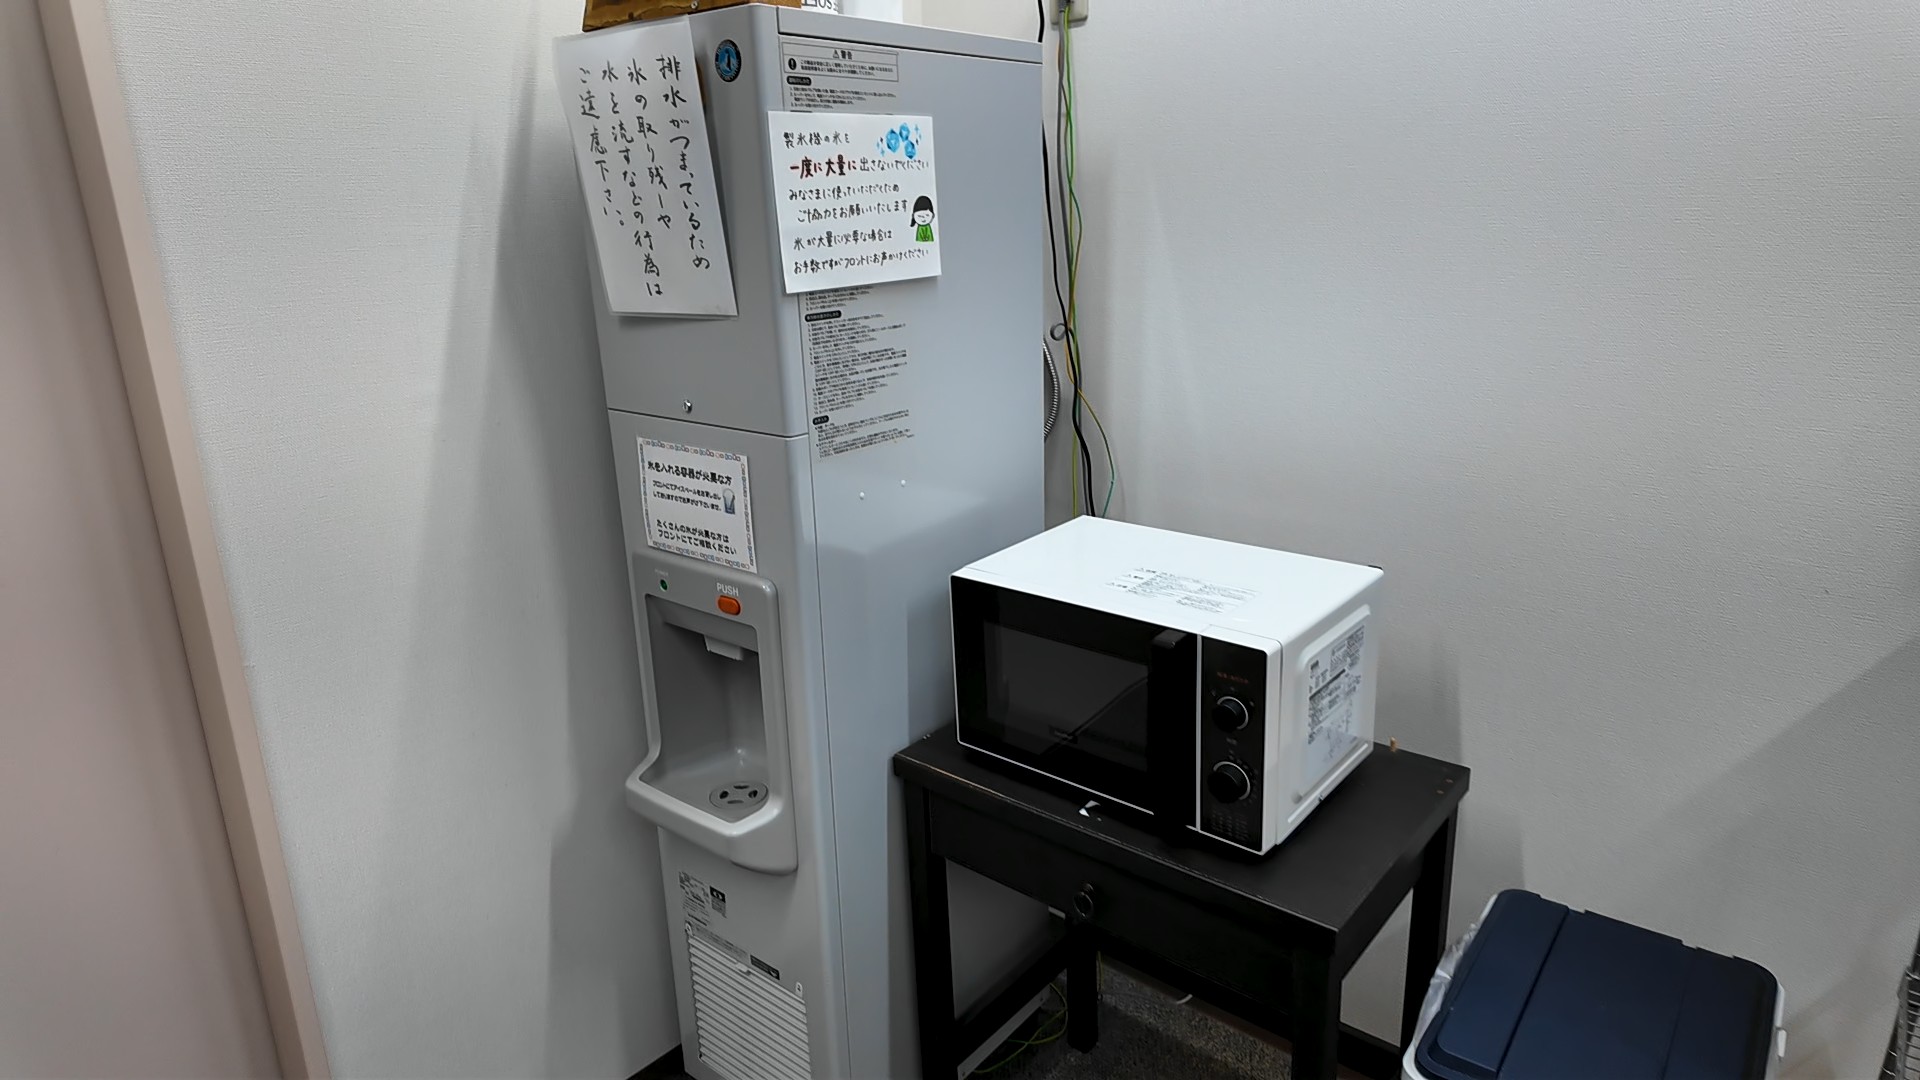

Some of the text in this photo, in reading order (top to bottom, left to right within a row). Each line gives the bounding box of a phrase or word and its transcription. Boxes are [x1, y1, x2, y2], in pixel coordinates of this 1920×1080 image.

[601, 60, 664, 296] 水を流すなどの行為は
[626, 58, 672, 229] 氷の取り残しや
[656, 54, 710, 270] 排水がつまっているため
[783, 131, 850, 149] 製氷機の氷を
[716, 582, 739, 597] PUSH
